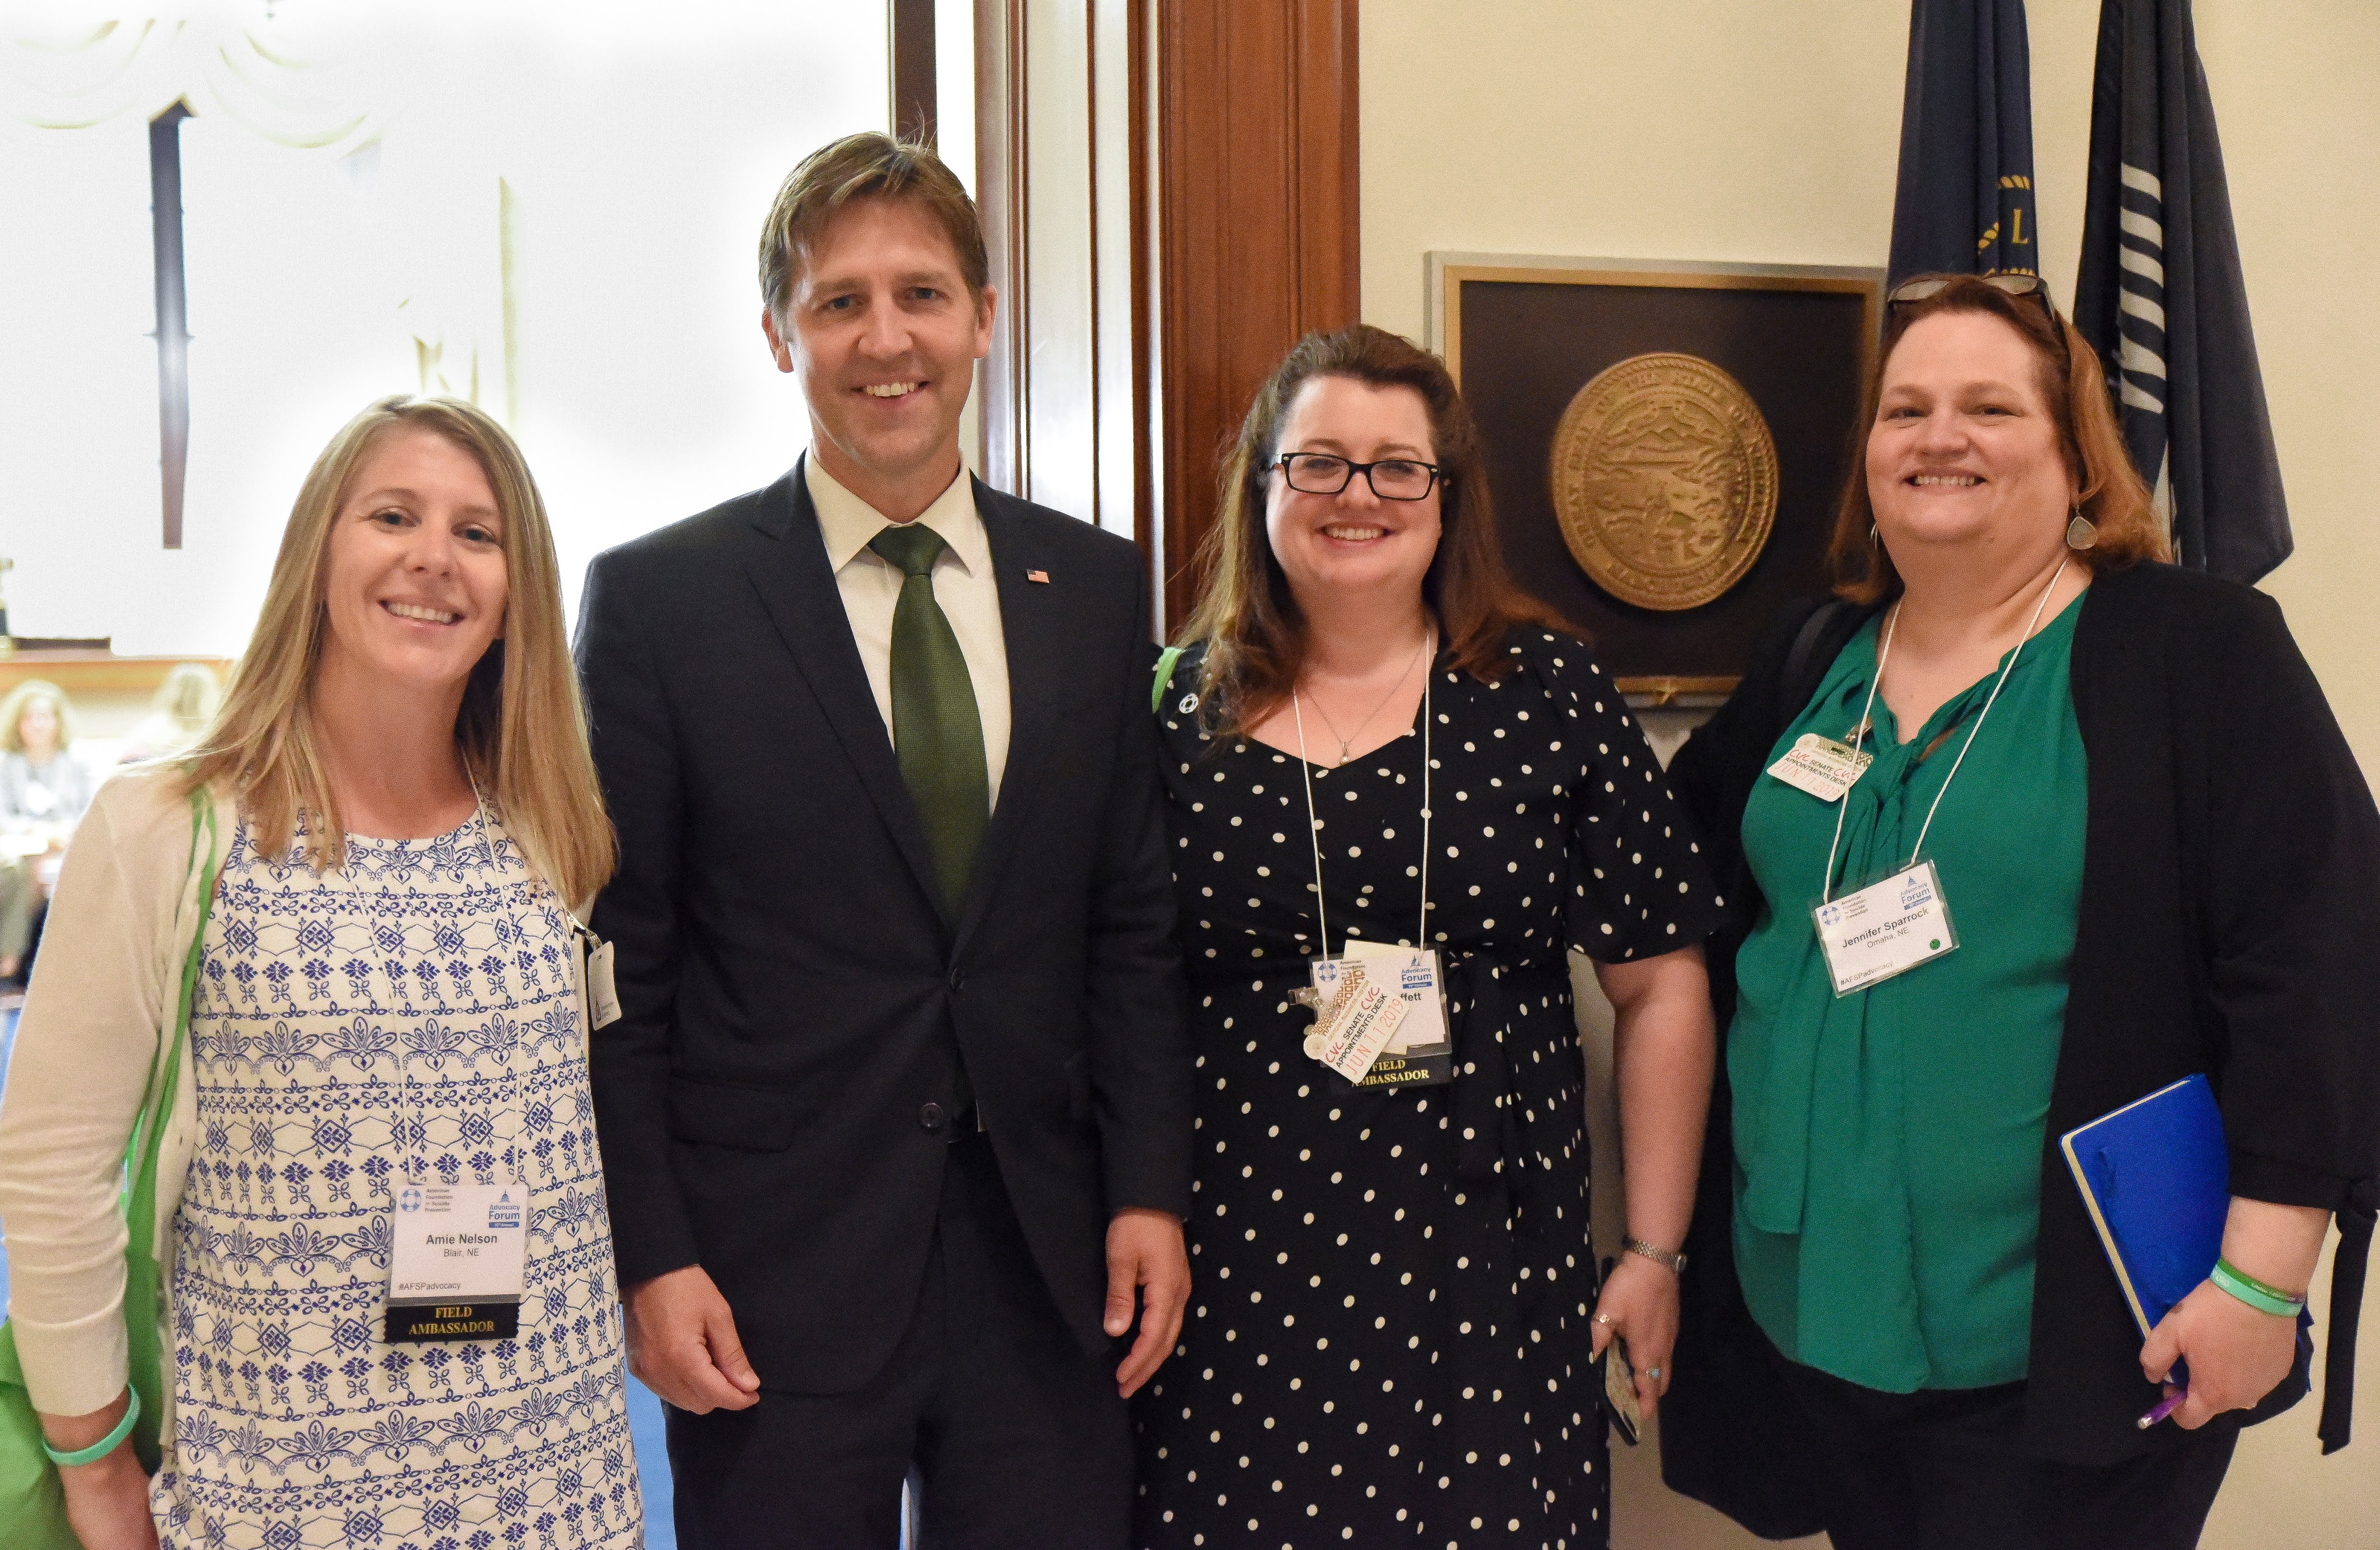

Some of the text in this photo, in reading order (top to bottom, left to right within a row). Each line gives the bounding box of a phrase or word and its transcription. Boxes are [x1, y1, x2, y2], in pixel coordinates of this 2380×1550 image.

[1774, 762, 1802, 778] JUN
[1784, 757, 1831, 780] APPOINTMENTS
[1830, 776, 1847, 787] DESK
[1809, 759, 1835, 773] SENATE
[1901, 888, 1930, 904] Forum
[1842, 907, 1929, 948] Jennifer Sparrock
[1897, 927, 1909, 937] NE
[1401, 974, 1432, 982] Forum
[1840, 961, 1893, 986] #AFSPadvocacy
[1325, 987, 1380, 1063] CVC SENATE CVC
[1335, 993, 1388, 1069] APPOINTMENTS DESK
[1346, 998, 1404, 1076] JUN 11 2019
[1372, 1059, 1406, 1072] FIELD
[488, 1210, 520, 1220] Forum
[426, 1234, 498, 1245] Amie Nelson
[443, 1248, 479, 1257] Blair, NE
[399, 1282, 461, 1290] #AFSPadvocacy
[435, 1307, 473, 1319] FIELD
[409, 1320, 495, 1335] AMBASSADOR
